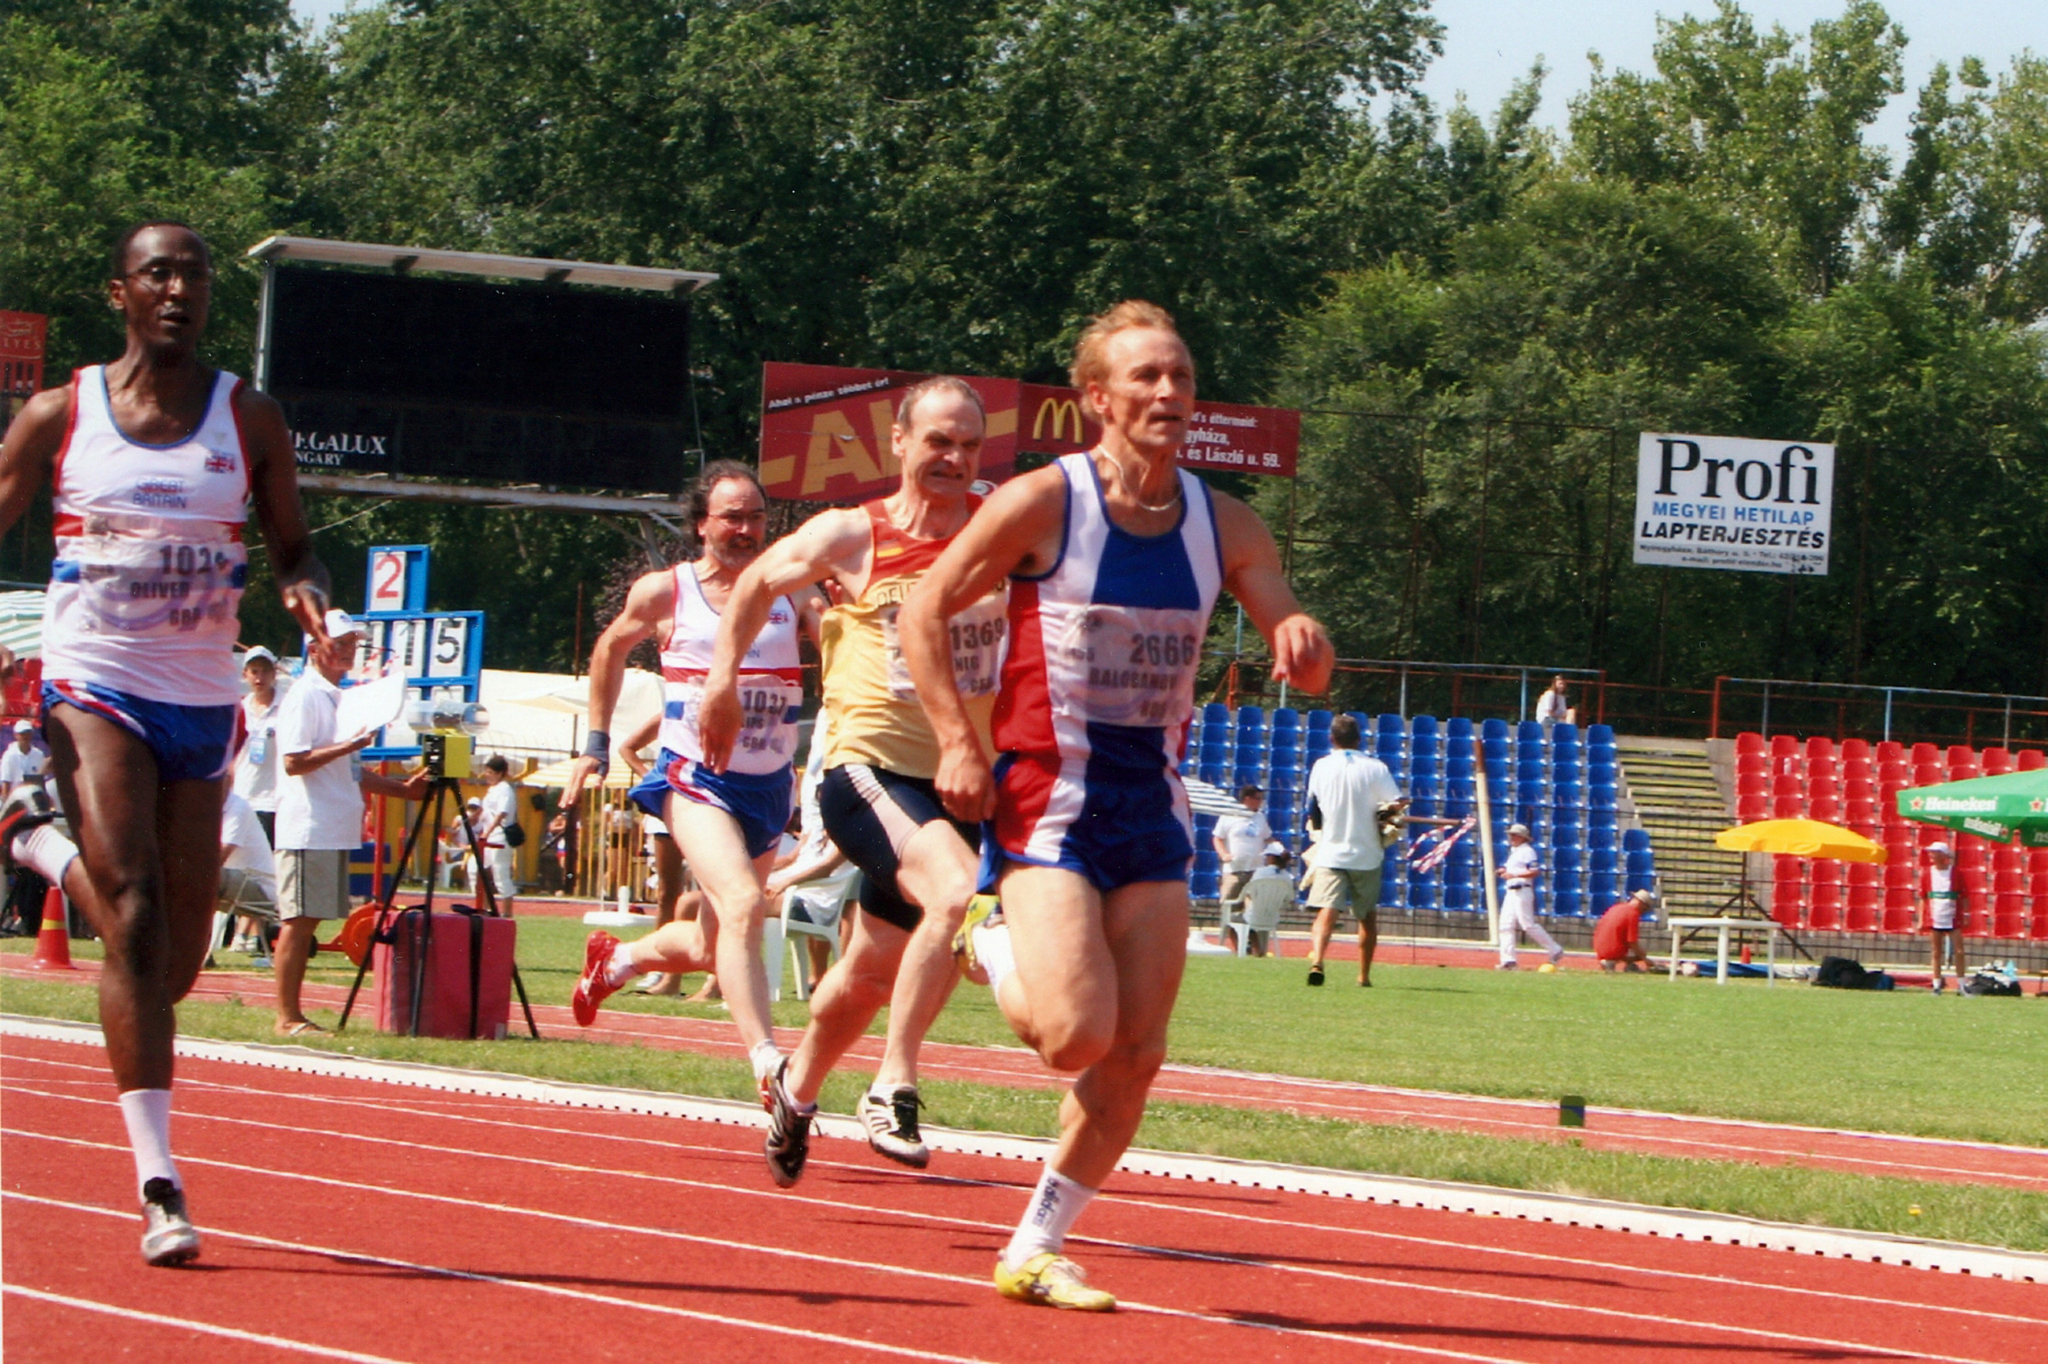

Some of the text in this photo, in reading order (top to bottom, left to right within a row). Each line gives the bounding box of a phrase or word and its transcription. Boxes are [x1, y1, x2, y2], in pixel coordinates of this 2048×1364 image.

[288, 429, 387, 455] EGALUX
[1184, 426, 1230, 446] gyháza,
[294, 450, 344, 466] NGARY
[1187, 444, 1202, 461] és
[1206, 446, 1245, 465] László
[1247, 454, 1259, 466] u.
[1263, 452, 1281, 468] 59.
[1654, 438, 1821, 505] Profi
[132, 492, 187, 508] BRITAIN
[1652, 501, 1815, 526] MEGYEI HETILAP
[1640, 520, 1825, 549] LAPTERJESZTÉS
[374, 554, 402, 599] 2
[1129, 633, 1197, 666] 2666
[954, 655, 980, 672] NIG
[1924, 796, 1998, 812] Heineken
